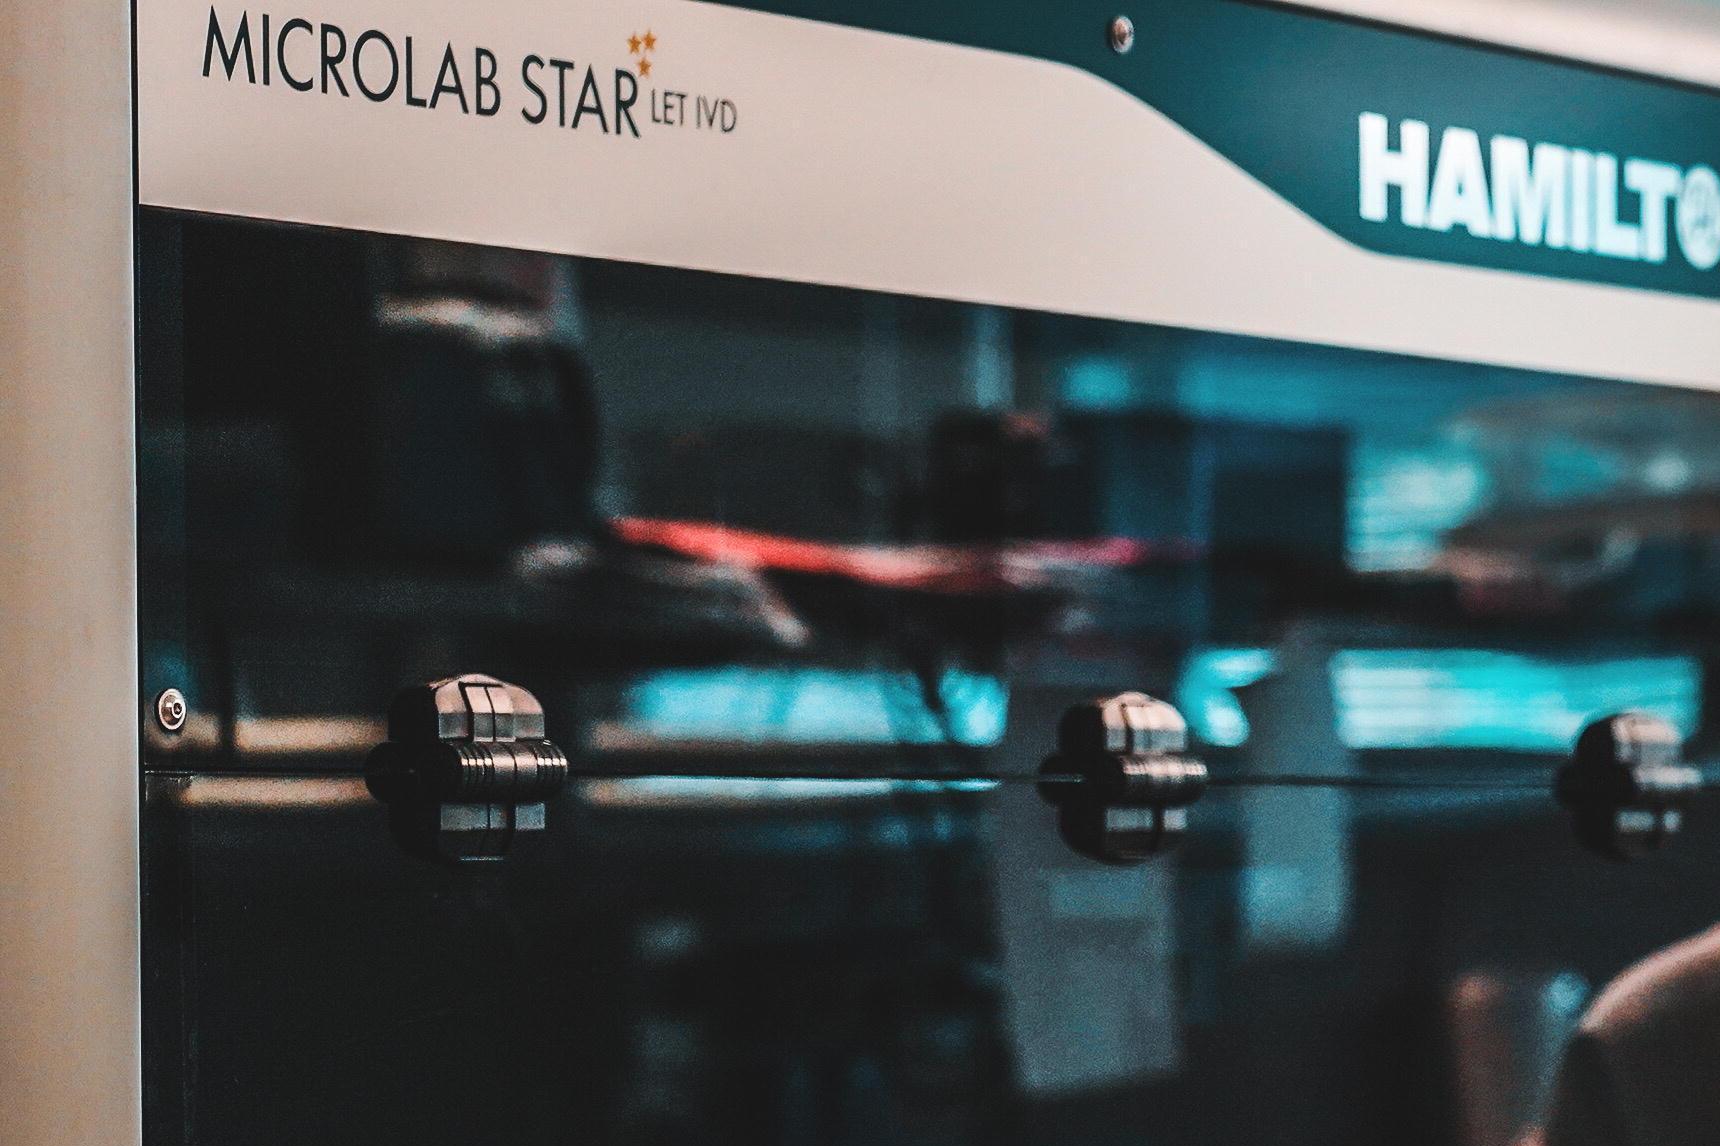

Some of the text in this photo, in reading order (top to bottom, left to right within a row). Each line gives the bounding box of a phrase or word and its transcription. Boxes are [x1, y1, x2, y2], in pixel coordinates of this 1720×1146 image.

[202, 4, 738, 139] MICROLAB STAR LET IVD
